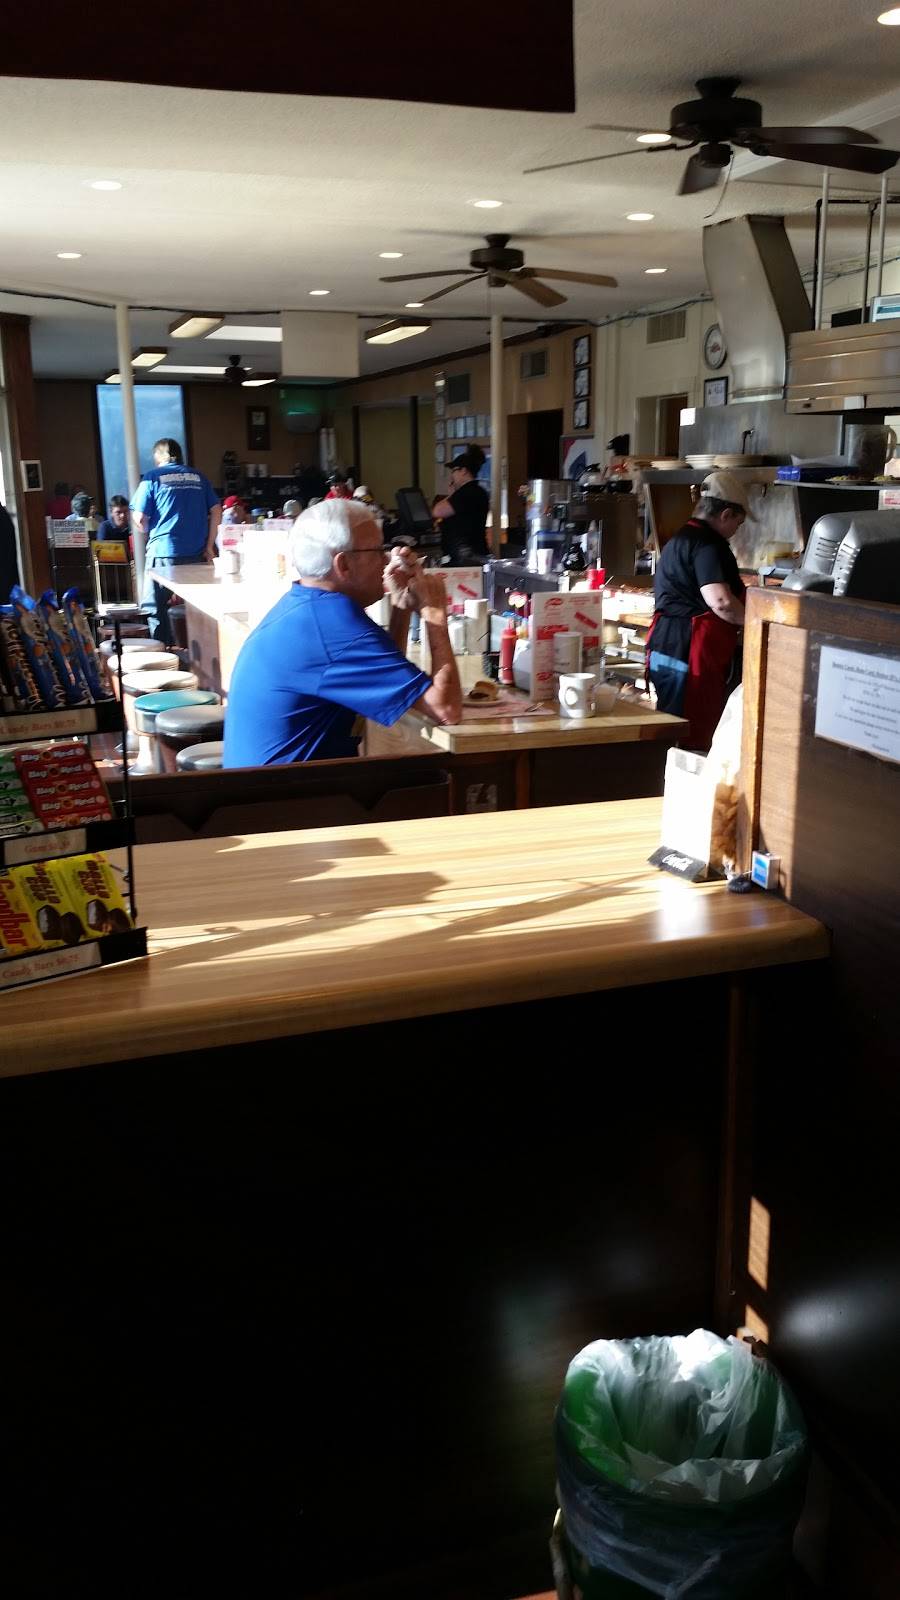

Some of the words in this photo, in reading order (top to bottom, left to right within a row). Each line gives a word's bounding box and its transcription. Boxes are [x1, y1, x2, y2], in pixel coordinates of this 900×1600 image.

[21, 754, 39, 762] Big
[53, 750, 75, 758] Red
[28, 770, 47, 778] Big
[61, 765, 81, 774] Red
[36, 787, 56, 795] Big
[68, 782, 90, 790] Red
[41, 802, 61, 811] Big
[75, 797, 96, 805] Red
